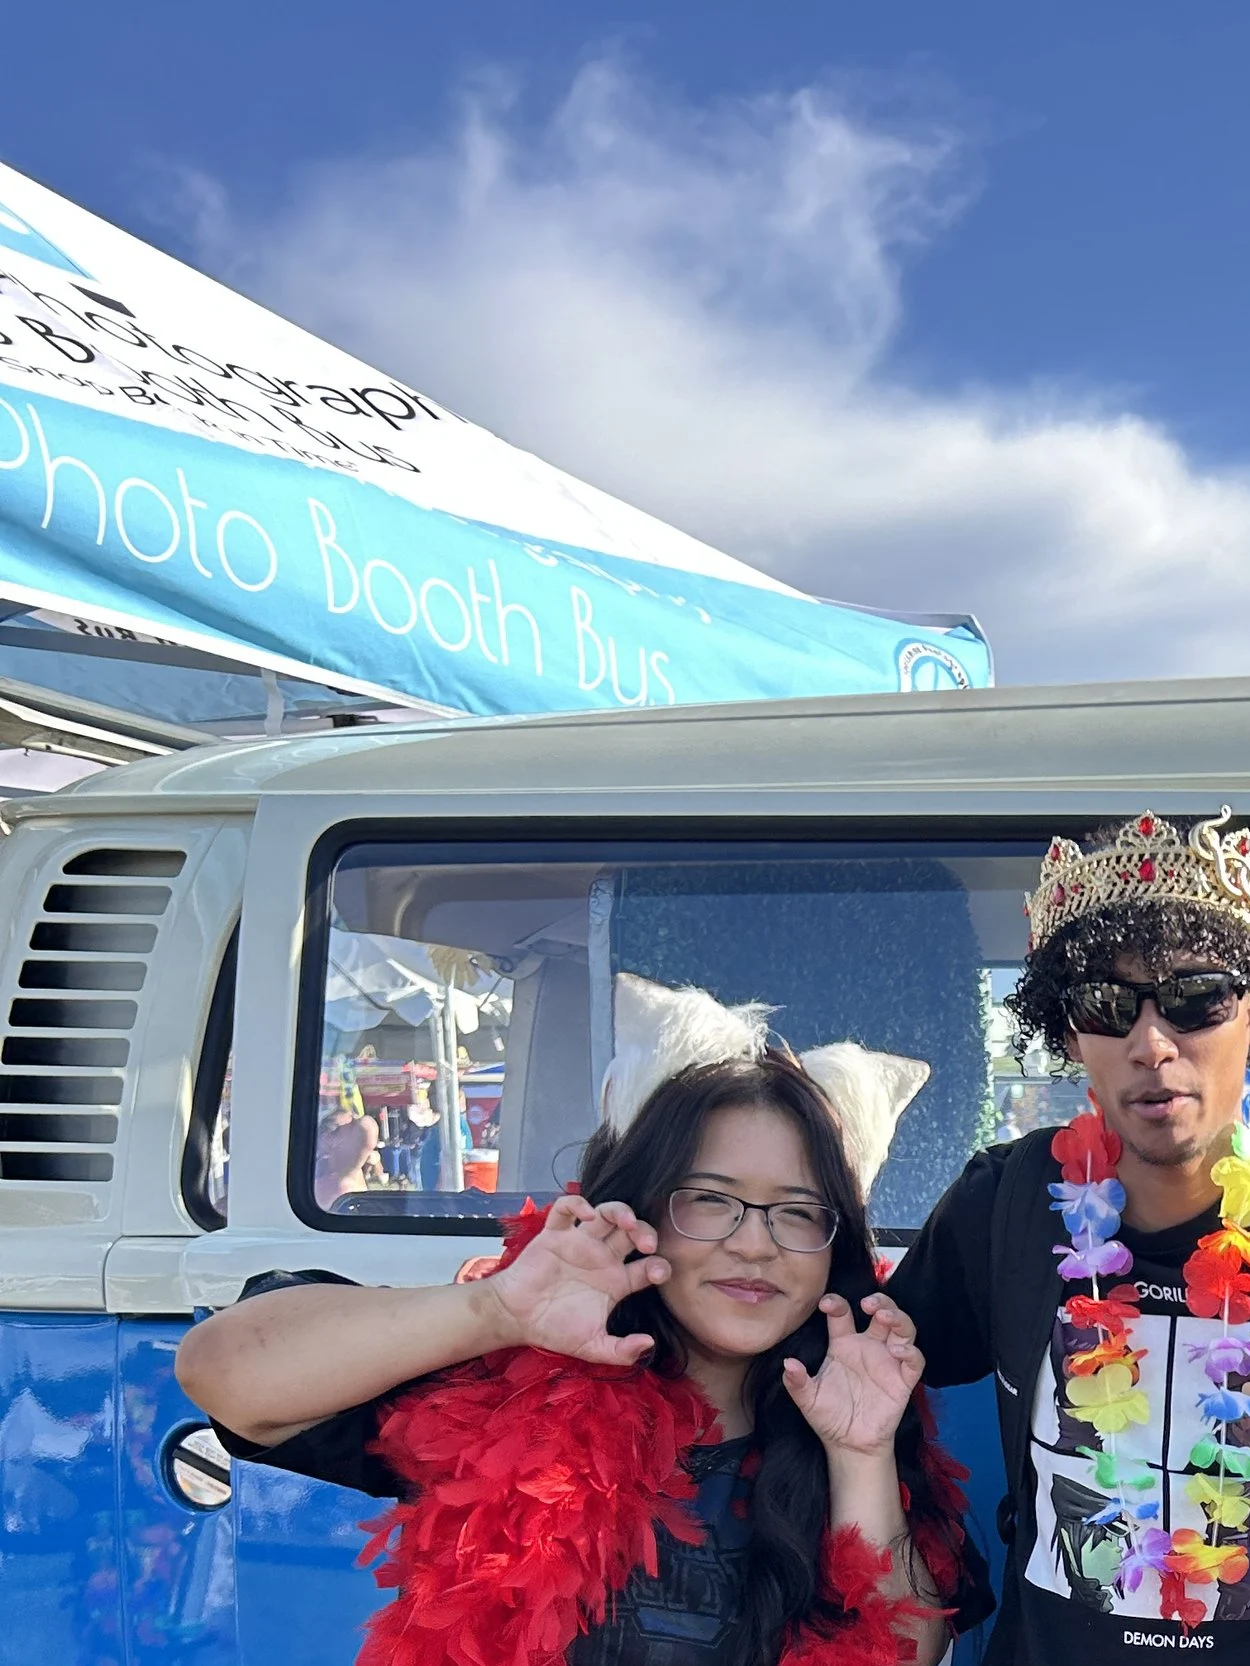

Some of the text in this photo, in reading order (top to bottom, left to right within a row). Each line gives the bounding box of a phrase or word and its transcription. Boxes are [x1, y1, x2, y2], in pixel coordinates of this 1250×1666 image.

[0, 269, 469, 431] hotograph
[269, 404, 422, 474] Bus
[308, 498, 543, 677] Booth
[570, 584, 676, 706] Bus
[1133, 1280, 1188, 1303] GORIL
[1123, 1630, 1214, 1649] DEMON DAYS
